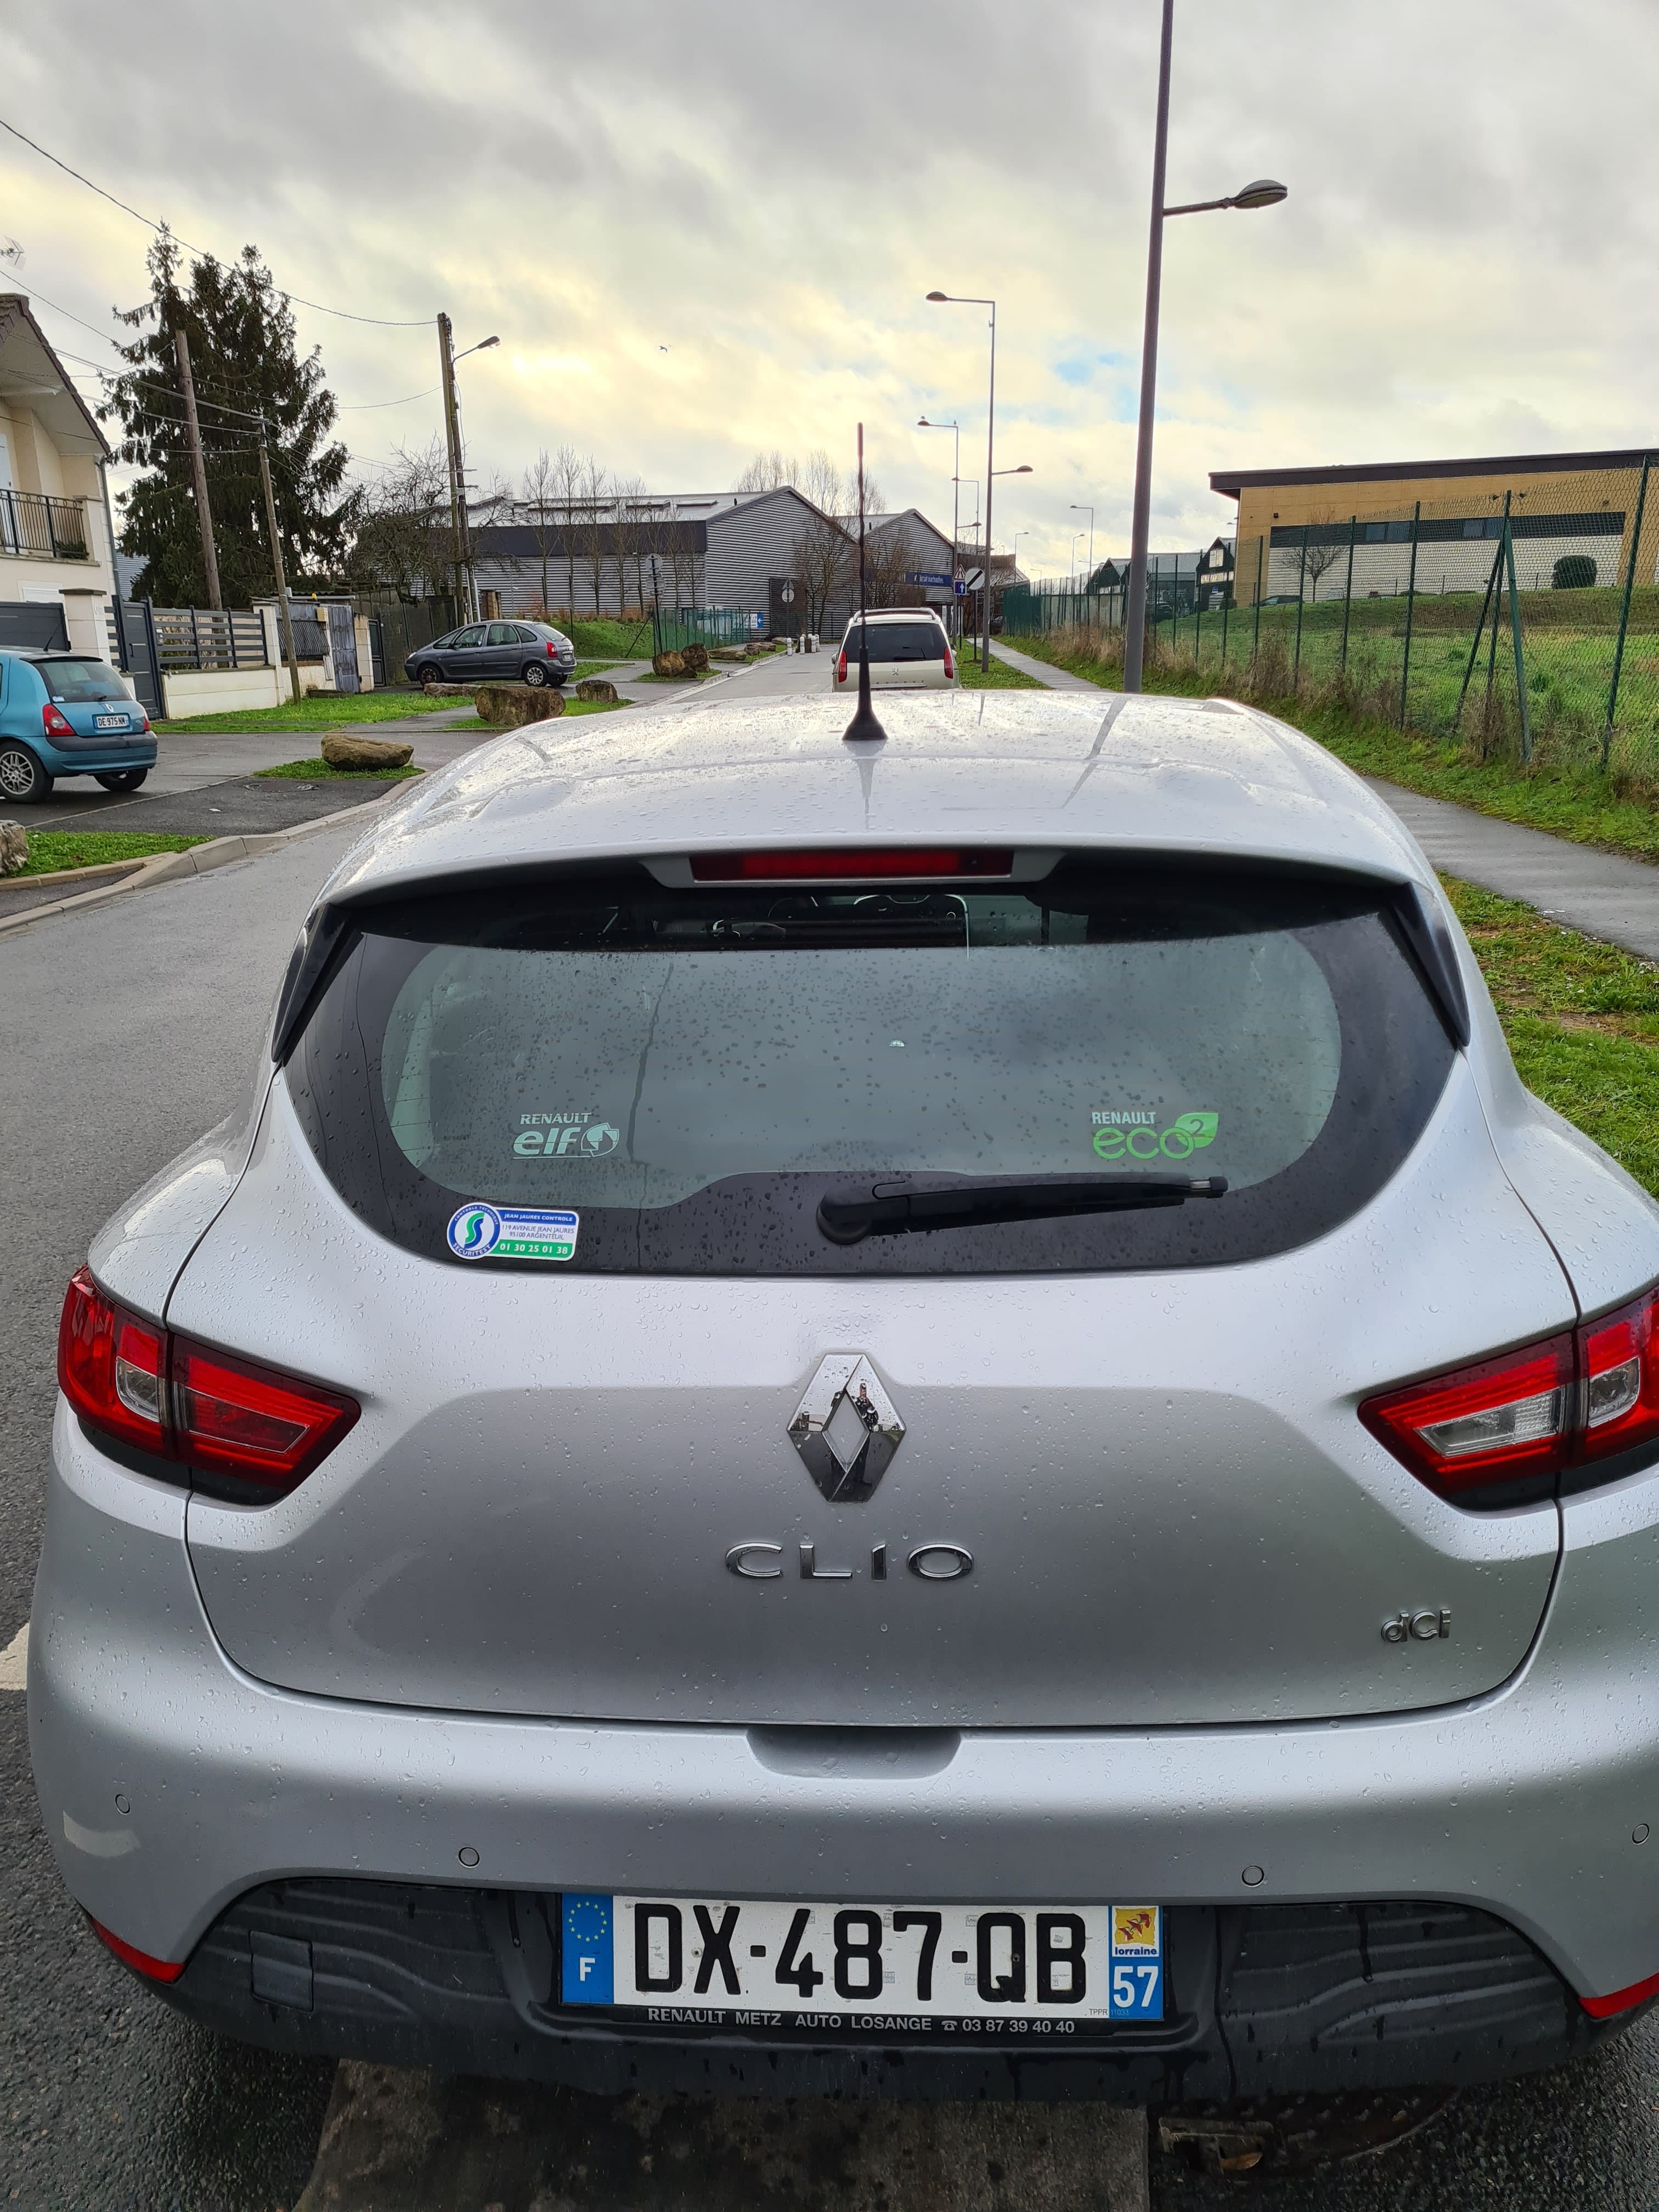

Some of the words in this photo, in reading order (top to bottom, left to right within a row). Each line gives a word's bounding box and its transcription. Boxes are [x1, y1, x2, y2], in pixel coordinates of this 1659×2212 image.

[521, 1113, 592, 1125] RENAULT
[1092, 1112, 1156, 1124] RENAULT
[514, 1127, 582, 1155] elf
[454, 1206, 477, 1222] CONTROLE
[479, 1206, 499, 1225] TECHNIQUE
[453, 1243, 490, 1256] SECURITEST
[725, 1541, 974, 1580] CLIO
[1381, 1609, 1451, 1643] dCi
[634, 1903, 1086, 2004] DX-487-QB
[1115, 1947, 1158, 1955] lorraine
[579, 1957, 596, 1982] F
[1113, 1966, 1159, 2007] 57
[648, 2008, 726, 2024] RENAULT
[736, 2012, 782, 2026] METZ
[795, 2014, 842, 2028] AUTO
[851, 2016, 932, 2030] LOSANGE
[962, 2018, 981, 2031] 03
[986, 2019, 1004, 2032] 87
[1009, 2020, 1028, 2033] 39
[1032, 2020, 1051, 2033] 40
[1056, 2021, 1075, 2034] 40
